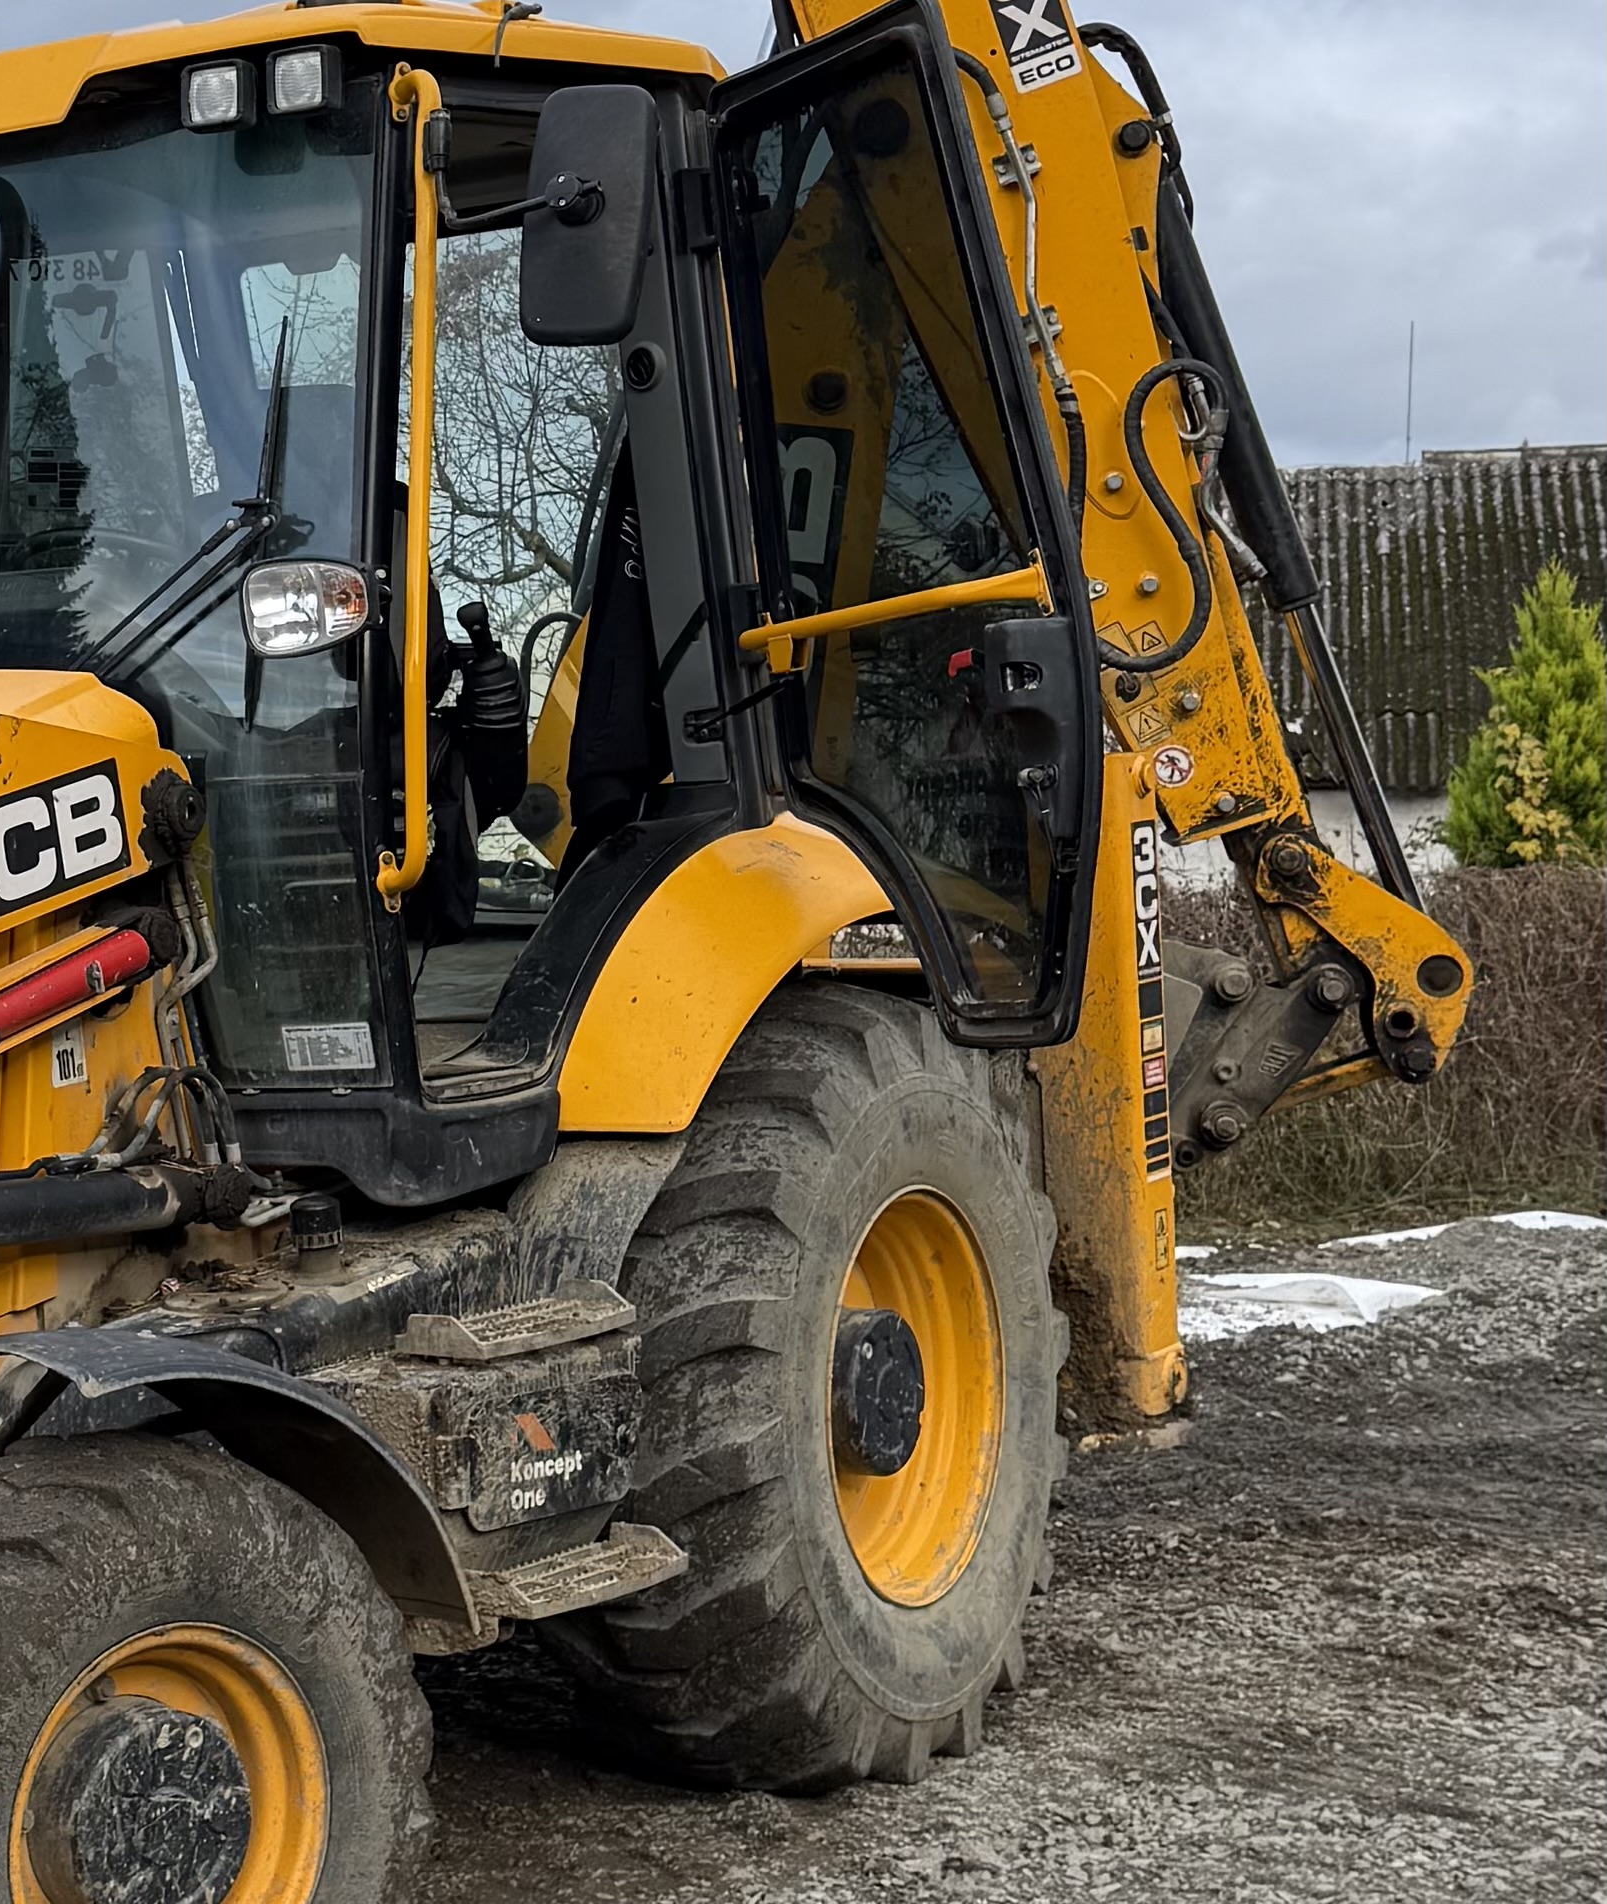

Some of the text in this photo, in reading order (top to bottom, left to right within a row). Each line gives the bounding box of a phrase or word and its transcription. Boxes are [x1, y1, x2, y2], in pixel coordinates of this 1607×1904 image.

[1019, 54, 1075, 86] ECO
[1134, 826, 1160, 967] 3CX
[56, 1048, 76, 1080] 101
[511, 1450, 582, 1484] Koncept
[510, 1488, 546, 1510] One
